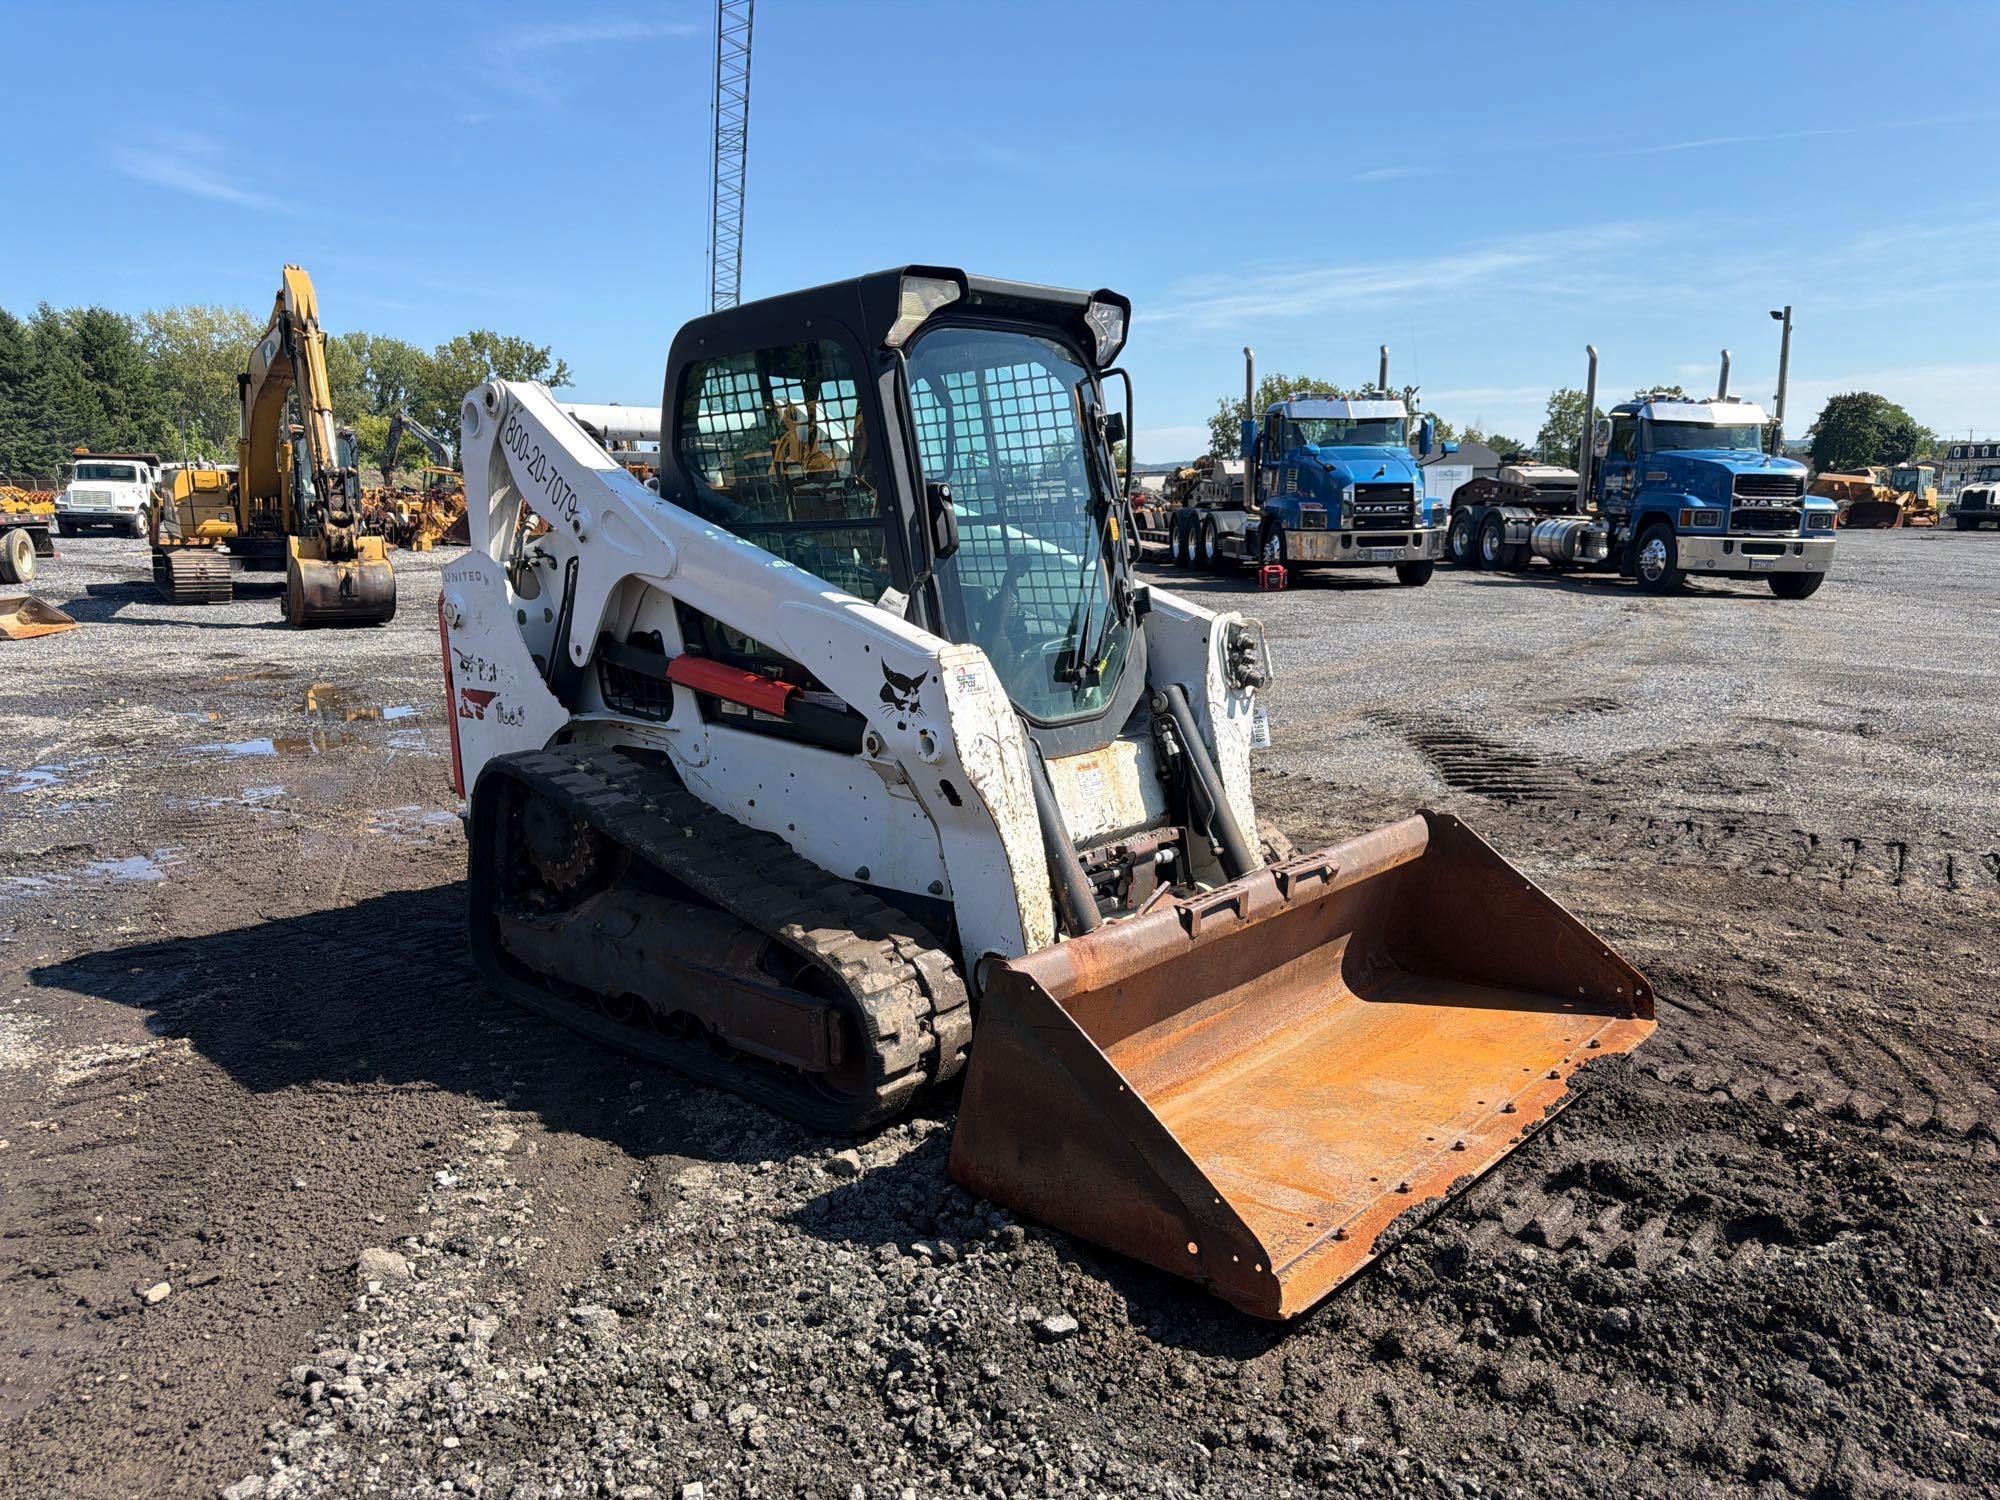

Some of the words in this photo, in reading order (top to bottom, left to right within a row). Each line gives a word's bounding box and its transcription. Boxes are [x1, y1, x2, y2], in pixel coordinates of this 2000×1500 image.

[505, 415, 579, 523] 800-20-7079
[1355, 505, 1409, 513] MACK
[1741, 499, 1793, 508] MACK
[444, 570, 482, 583] UNITED
